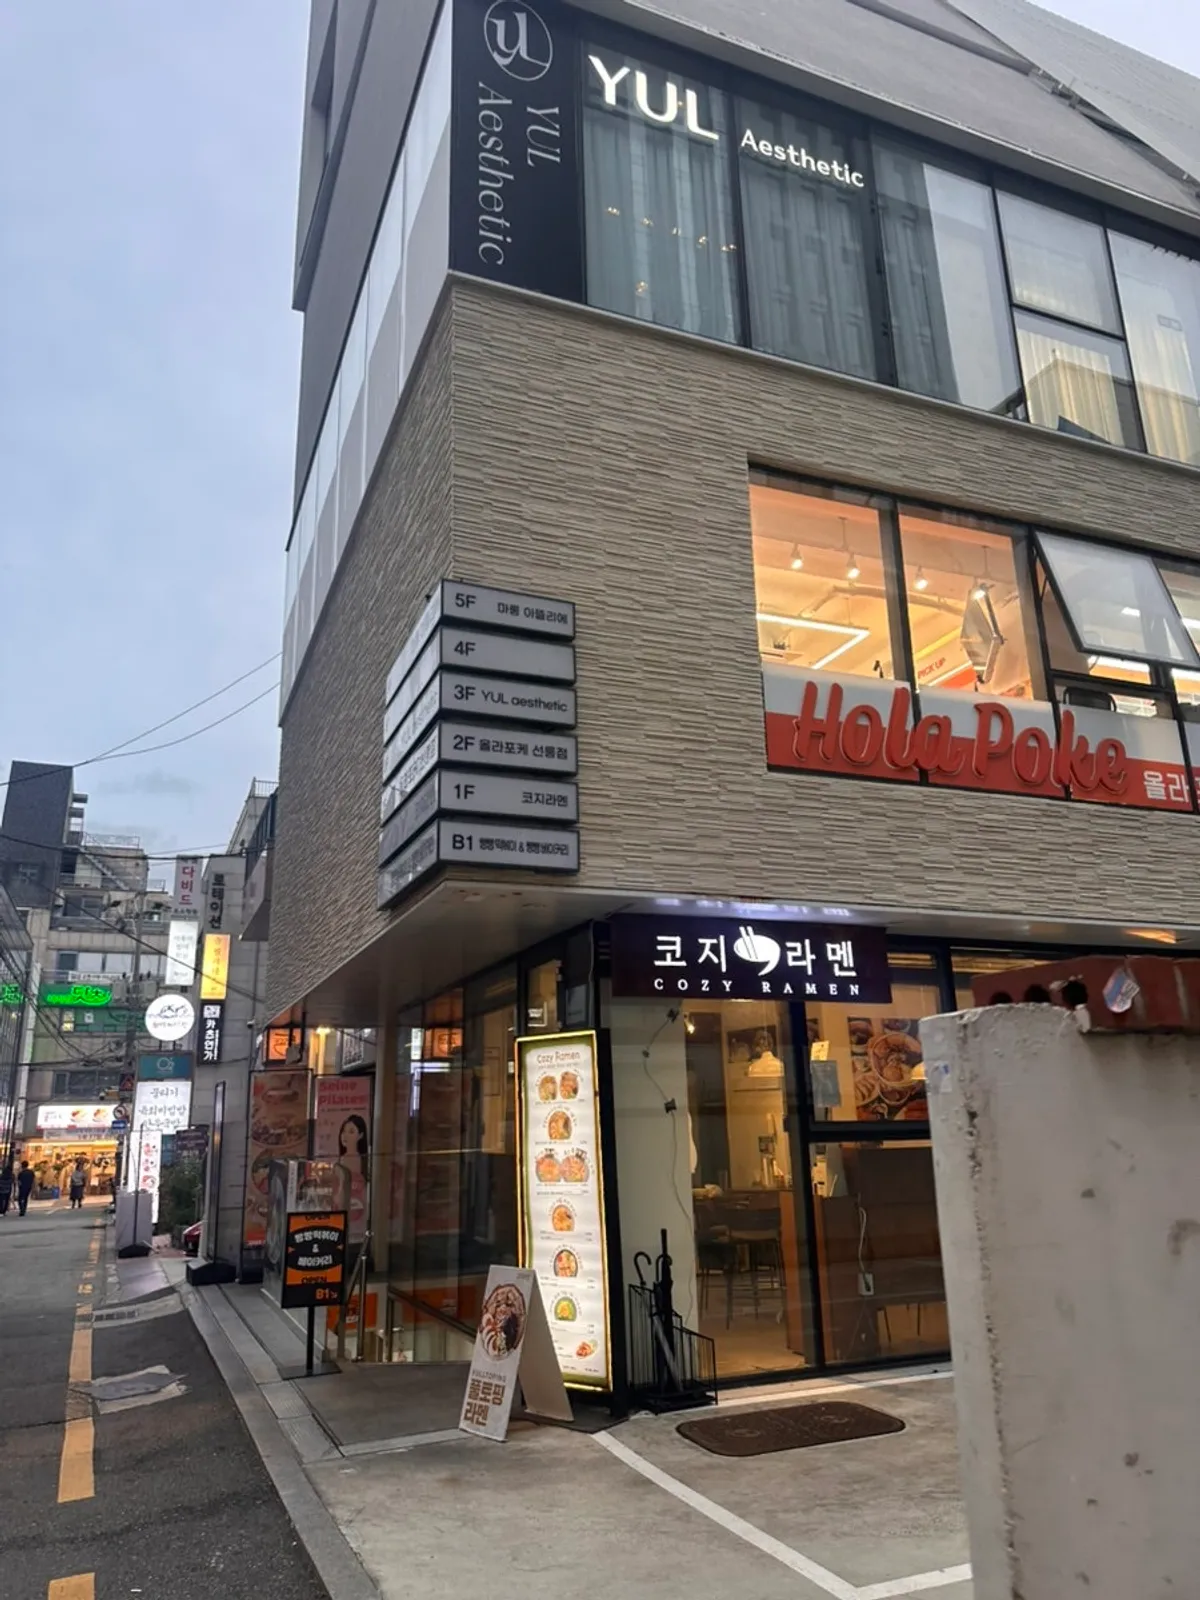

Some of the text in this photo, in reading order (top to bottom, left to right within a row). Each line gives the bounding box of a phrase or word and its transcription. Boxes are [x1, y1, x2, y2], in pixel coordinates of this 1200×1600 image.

[588, 54, 865, 189] YUL Aesthetic
[526, 105, 562, 167] YUL
[478, 81, 515, 265] Aesthetic
[454, 592, 477, 609] 5F
[453, 640, 477, 656] 4F
[453, 684, 569, 713] 3F YUL aesthetic
[453, 734, 476, 751] 2F
[792, 680, 1130, 796] Hola Poke
[453, 783, 477, 800] 1F
[1143, 770, 1200, 804] 올라
[452, 834, 474, 851] B1
[653, 978, 860, 995] COZY RAMEN
